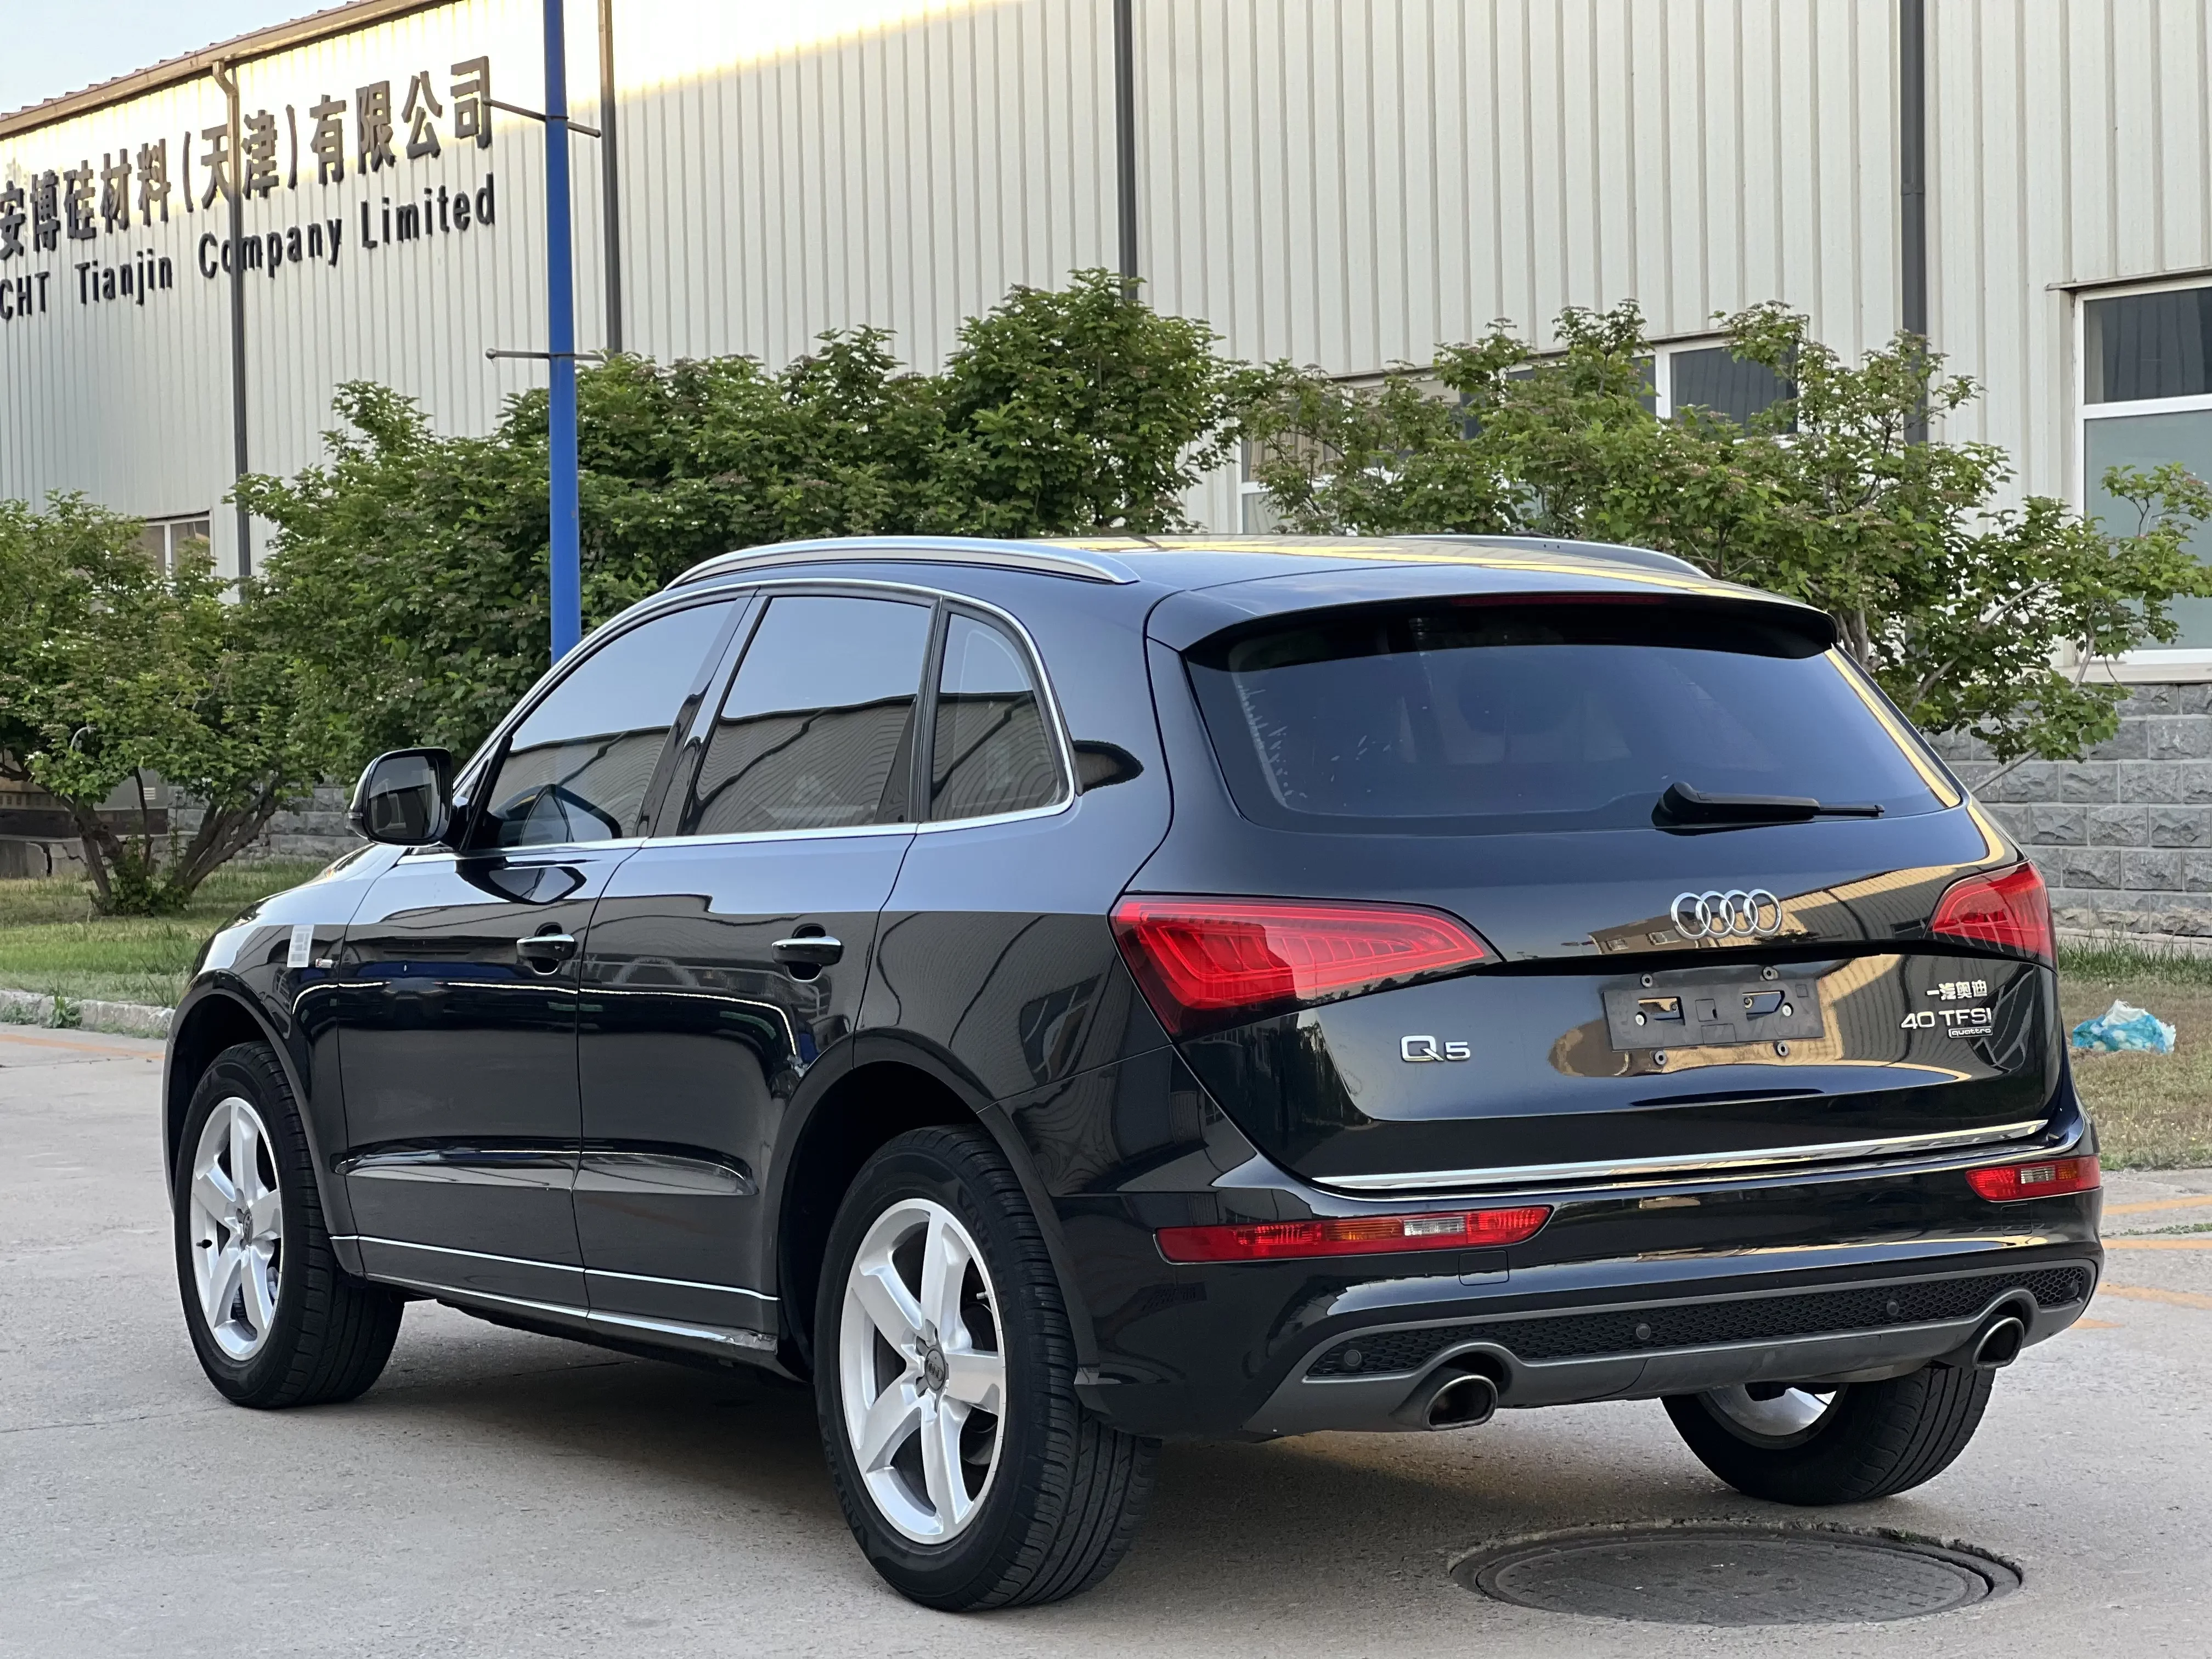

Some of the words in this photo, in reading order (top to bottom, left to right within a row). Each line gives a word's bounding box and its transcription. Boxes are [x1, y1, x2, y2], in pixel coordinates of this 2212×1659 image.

[0, 271, 50, 321] CHT
[74, 247, 173, 306] Tianjin
[360, 171, 495, 249] Limited
[1926, 979, 1988, 1001] 一汽奥迪
[1900, 1011, 1936, 1029] 40
[1938, 1007, 1993, 1026] TFSI
[1951, 1028, 1992, 1037] quattro
[1401, 1035, 1471, 1062] Q5
